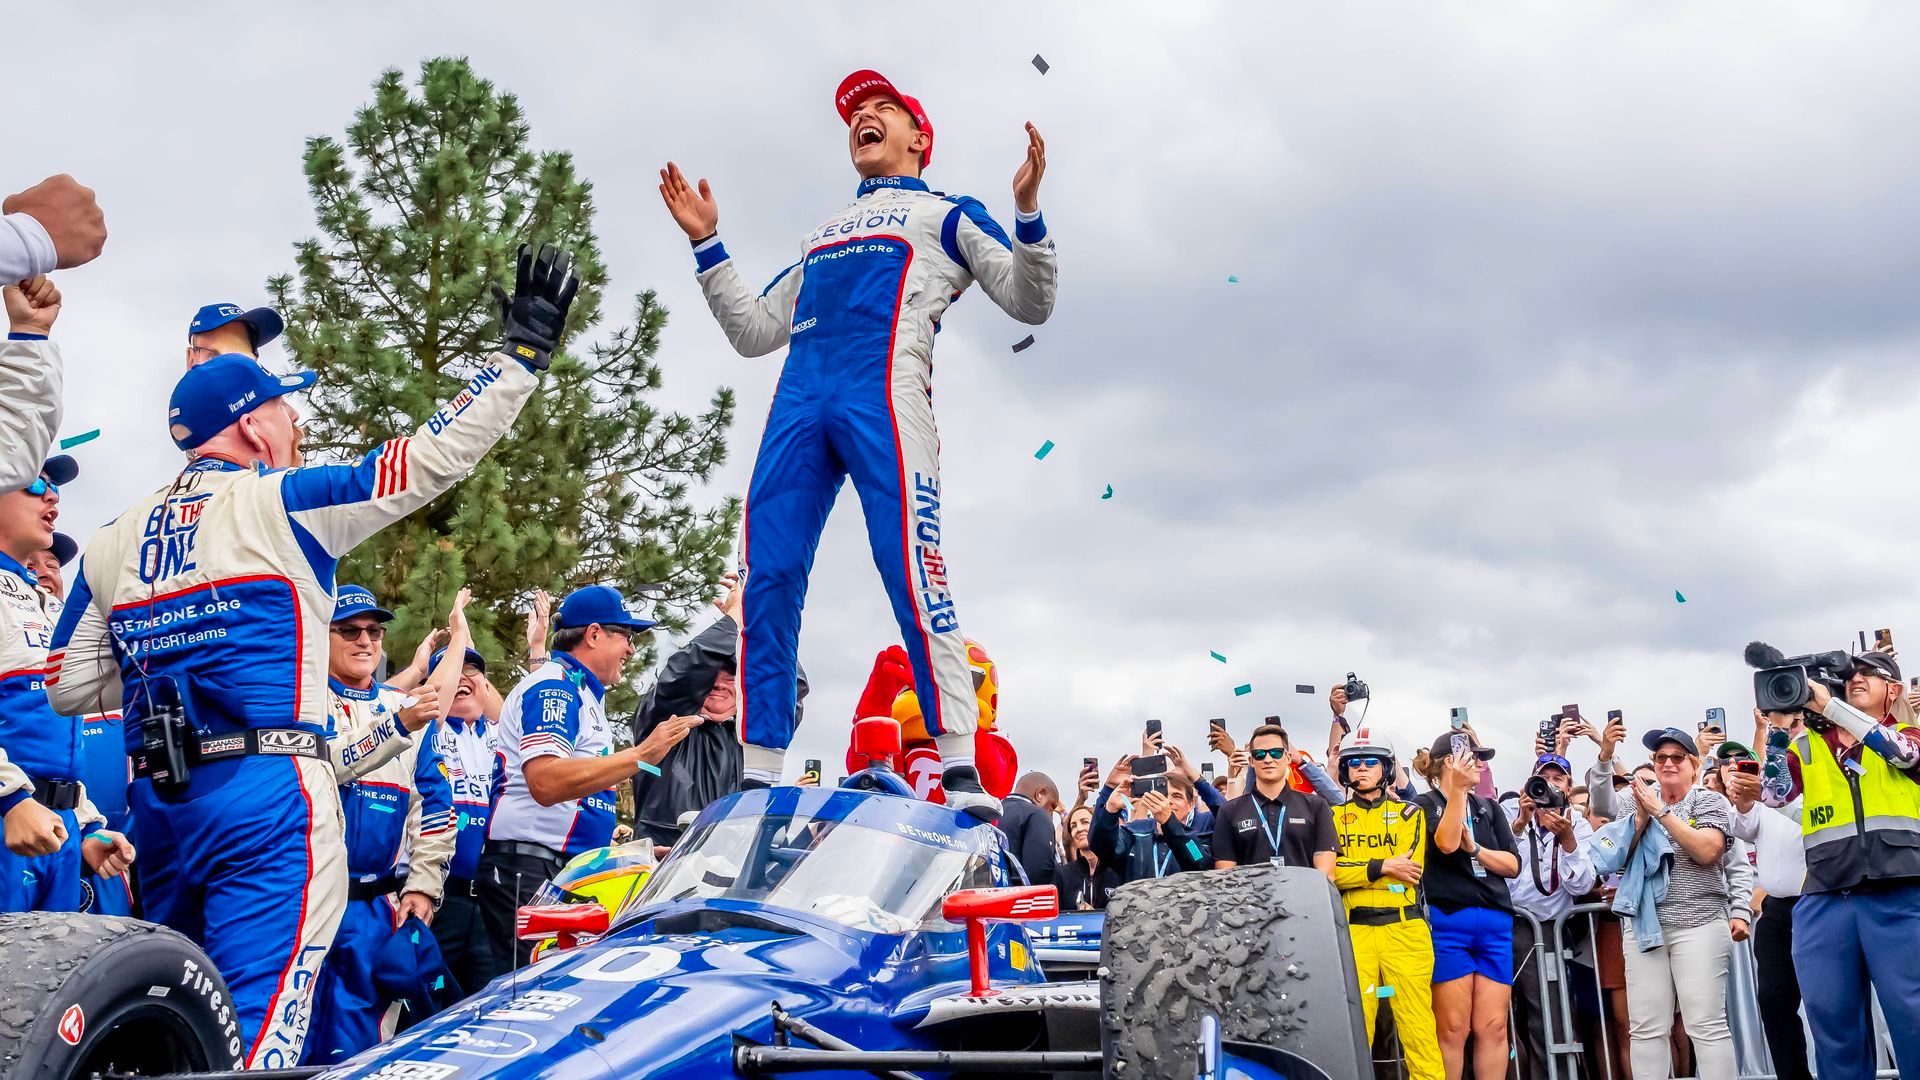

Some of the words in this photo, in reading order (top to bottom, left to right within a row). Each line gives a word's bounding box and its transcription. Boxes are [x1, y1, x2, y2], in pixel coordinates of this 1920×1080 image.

[864, 178, 901, 187] LEGION
[810, 214, 908, 243] LEGION
[807, 244, 894, 266] BETHEONE.ORG
[427, 410, 454, 436] BE
[451, 391, 472, 411] THE
[467, 363, 502, 396] ONE
[143, 497, 178, 538] BE
[915, 472, 941, 546] ONE
[139, 524, 199, 585] ONE
[924, 547, 947, 586] THE
[110, 598, 241, 634] BETHEONE.ORG
[338, 596, 378, 608] LEGION
[924, 592, 959, 634] BE
[141, 628, 228, 652] @CGRTeams
[343, 690, 371, 700] LEGION
[342, 743, 360, 767] BE
[357, 736, 375, 754] THE
[372, 718, 394, 748] ONE
[896, 822, 968, 850] BETHEONE.ORG
